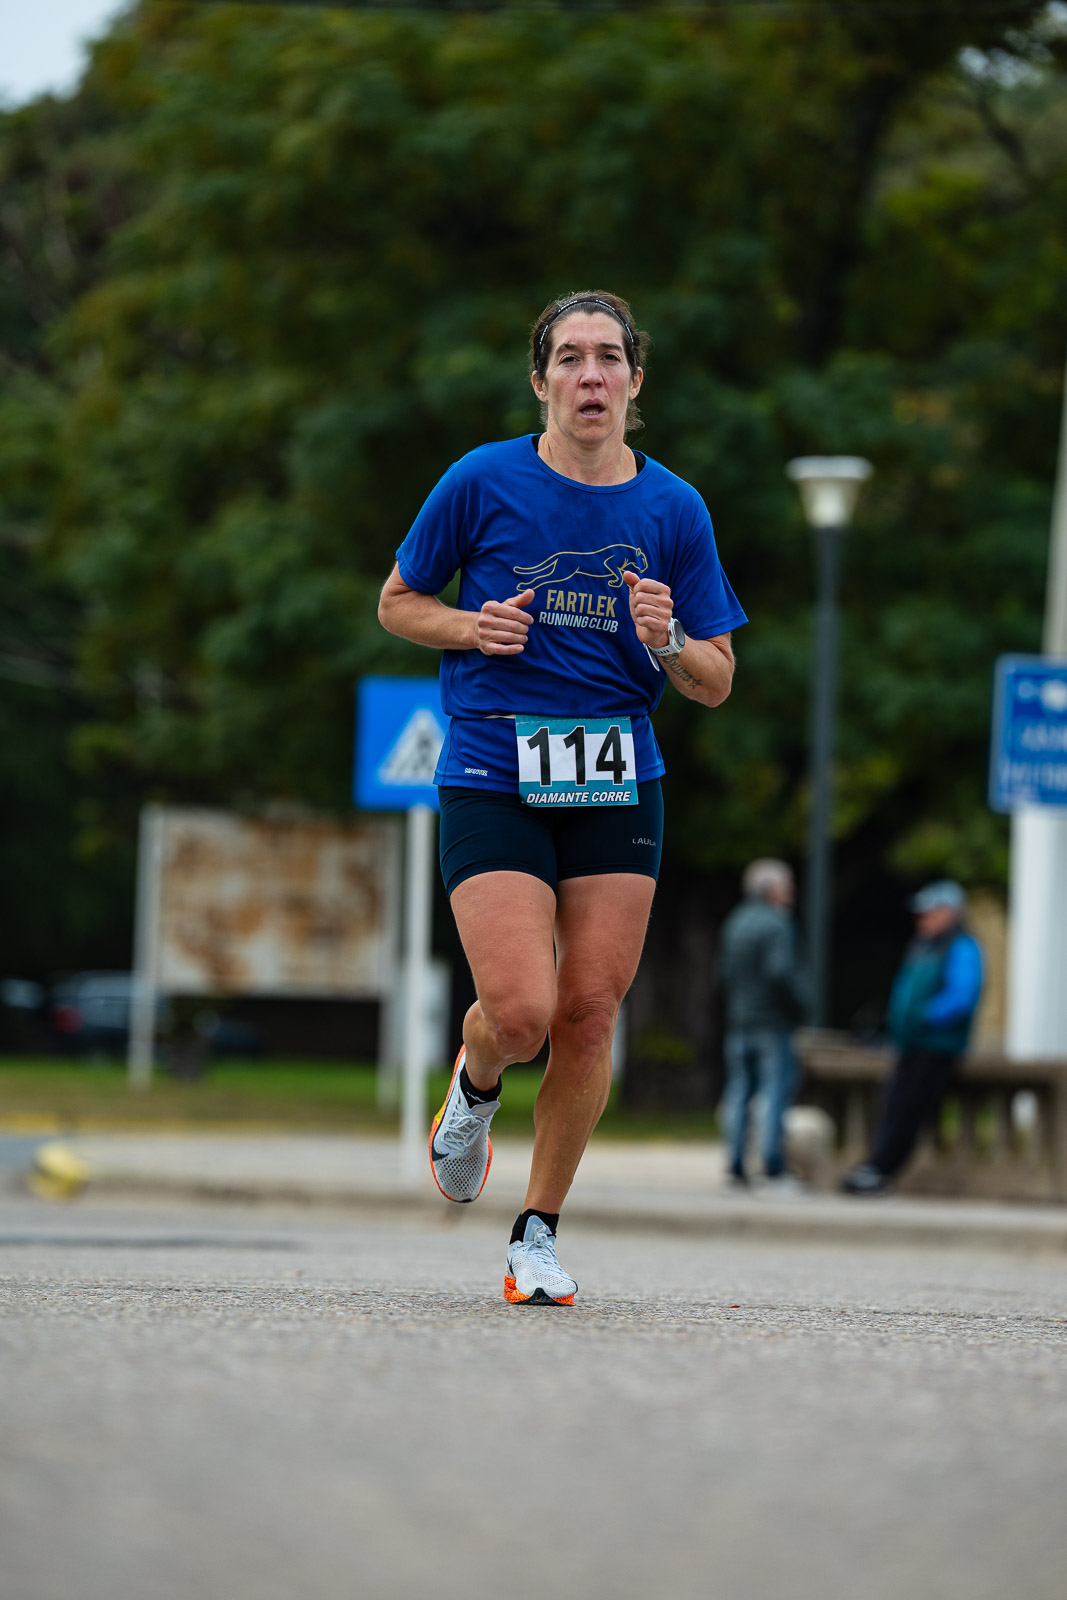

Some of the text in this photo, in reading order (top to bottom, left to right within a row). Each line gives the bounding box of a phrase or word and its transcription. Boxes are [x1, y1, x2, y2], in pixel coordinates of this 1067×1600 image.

[546, 589, 617, 618] FARTLEK
[526, 725, 627, 787] 114
[526, 791, 632, 804] DIAMANTE CORRE
